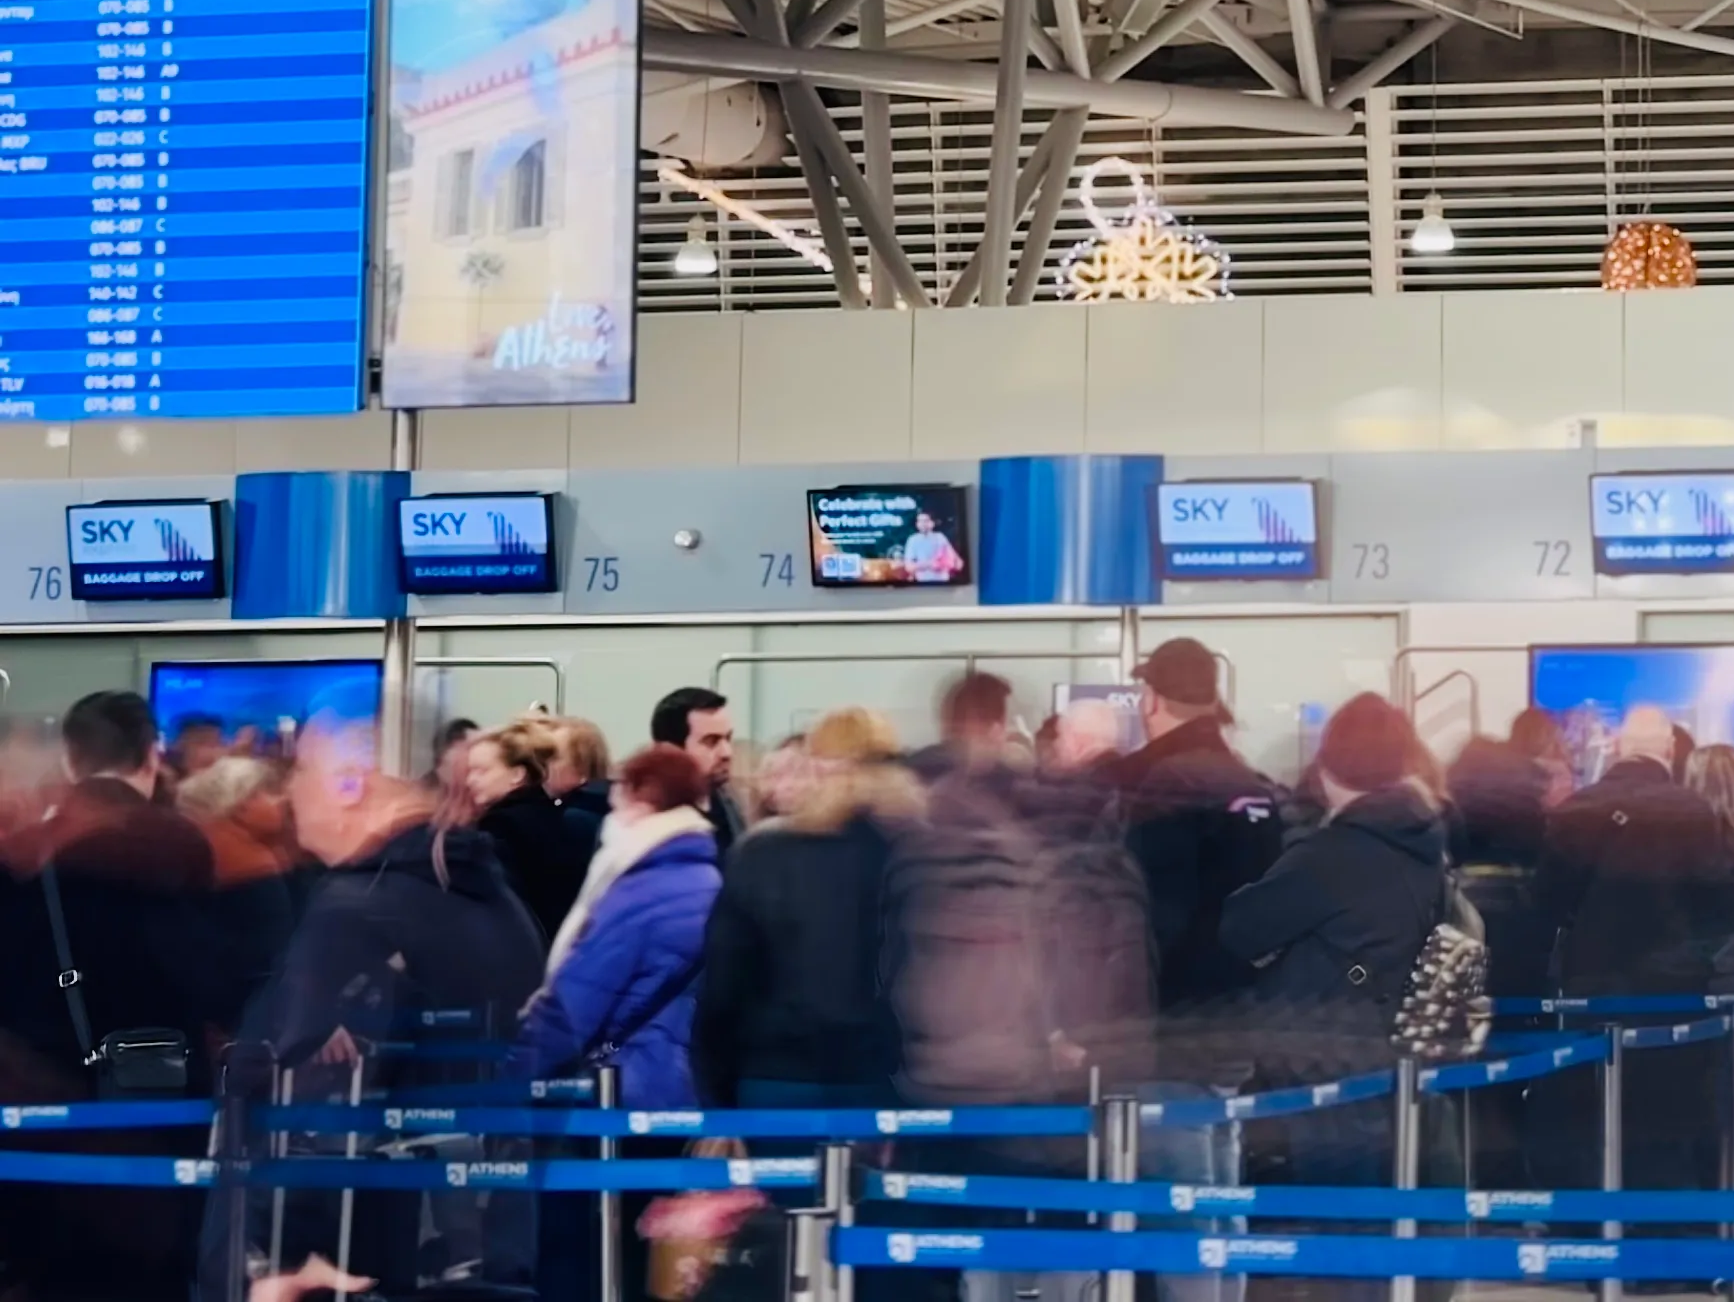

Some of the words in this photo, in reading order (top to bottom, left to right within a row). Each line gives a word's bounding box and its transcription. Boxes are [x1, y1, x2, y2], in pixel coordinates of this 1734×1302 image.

[158, 129, 168, 144] C
[155, 218, 165, 232] C
[153, 284, 163, 299] C
[153, 306, 163, 321] C
[151, 329, 162, 343] A
[149, 373, 161, 387] A
[818, 497, 883, 512] Celebrate
[1172, 497, 1229, 522] SKY
[1606, 490, 1667, 514] SKY
[412, 512, 467, 536] SKY
[818, 513, 868, 528] Perfect
[81, 519, 135, 544] SKY
[1238, 551, 1276, 565] DROP
[1277, 550, 1306, 564] OFF
[1352, 543, 1390, 581] 73
[1533, 540, 1572, 577] 72
[83, 572, 141, 585] BAGGAGE
[144, 571, 178, 583] DROP
[180, 570, 205, 582] OFF
[415, 566, 473, 577] BAGGAGE
[475, 565, 510, 577] DROP
[513, 564, 538, 576] OFF
[584, 557, 620, 593] 75
[759, 553, 796, 588] 74
[28, 566, 62, 601] 76
[547, 1079, 594, 1090] ATHENS
[404, 1109, 455, 1121] ATHENS
[900, 1110, 953, 1125] ATHENS
[468, 1162, 529, 1175] ATHENS
[750, 1158, 818, 1173] ATHENS
[908, 1175, 968, 1190] ATHENS
[1193, 1186, 1256, 1200] ATHENS
[1489, 1191, 1554, 1205] ATHENS
[914, 1234, 984, 1249] ATHENS
[1228, 1239, 1298, 1254] ATHENS
[1545, 1244, 1619, 1259] ATHENS
